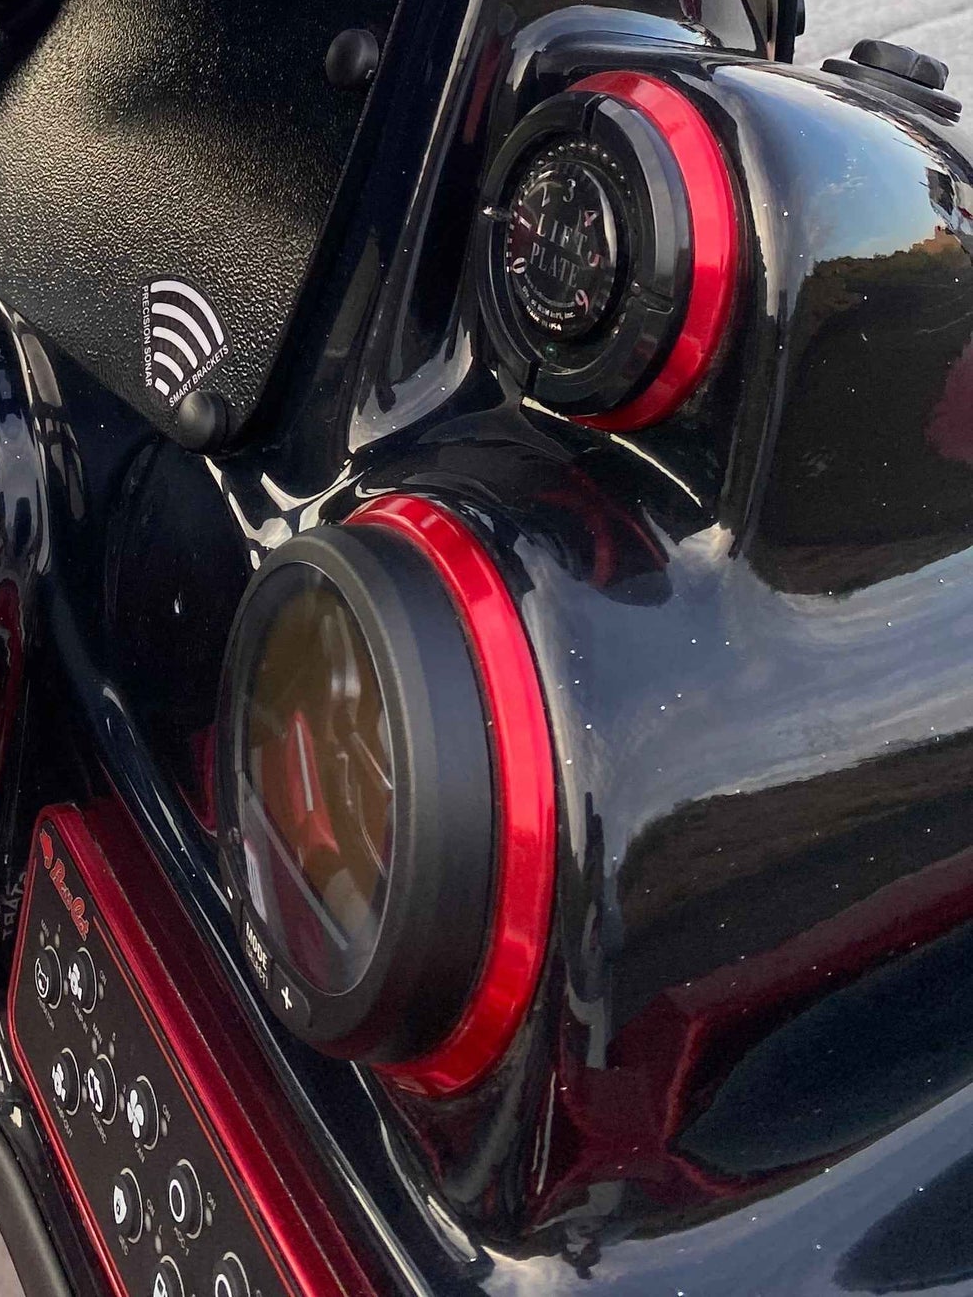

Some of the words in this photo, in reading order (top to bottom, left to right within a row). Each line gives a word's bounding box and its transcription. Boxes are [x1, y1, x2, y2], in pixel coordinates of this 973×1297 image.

[540, 184, 550, 207] 2
[563, 178, 576, 202] 3
[536, 213, 587, 256] LIFT
[530, 242, 579, 288] PLATE
[244, 921, 268, 971] MODE
